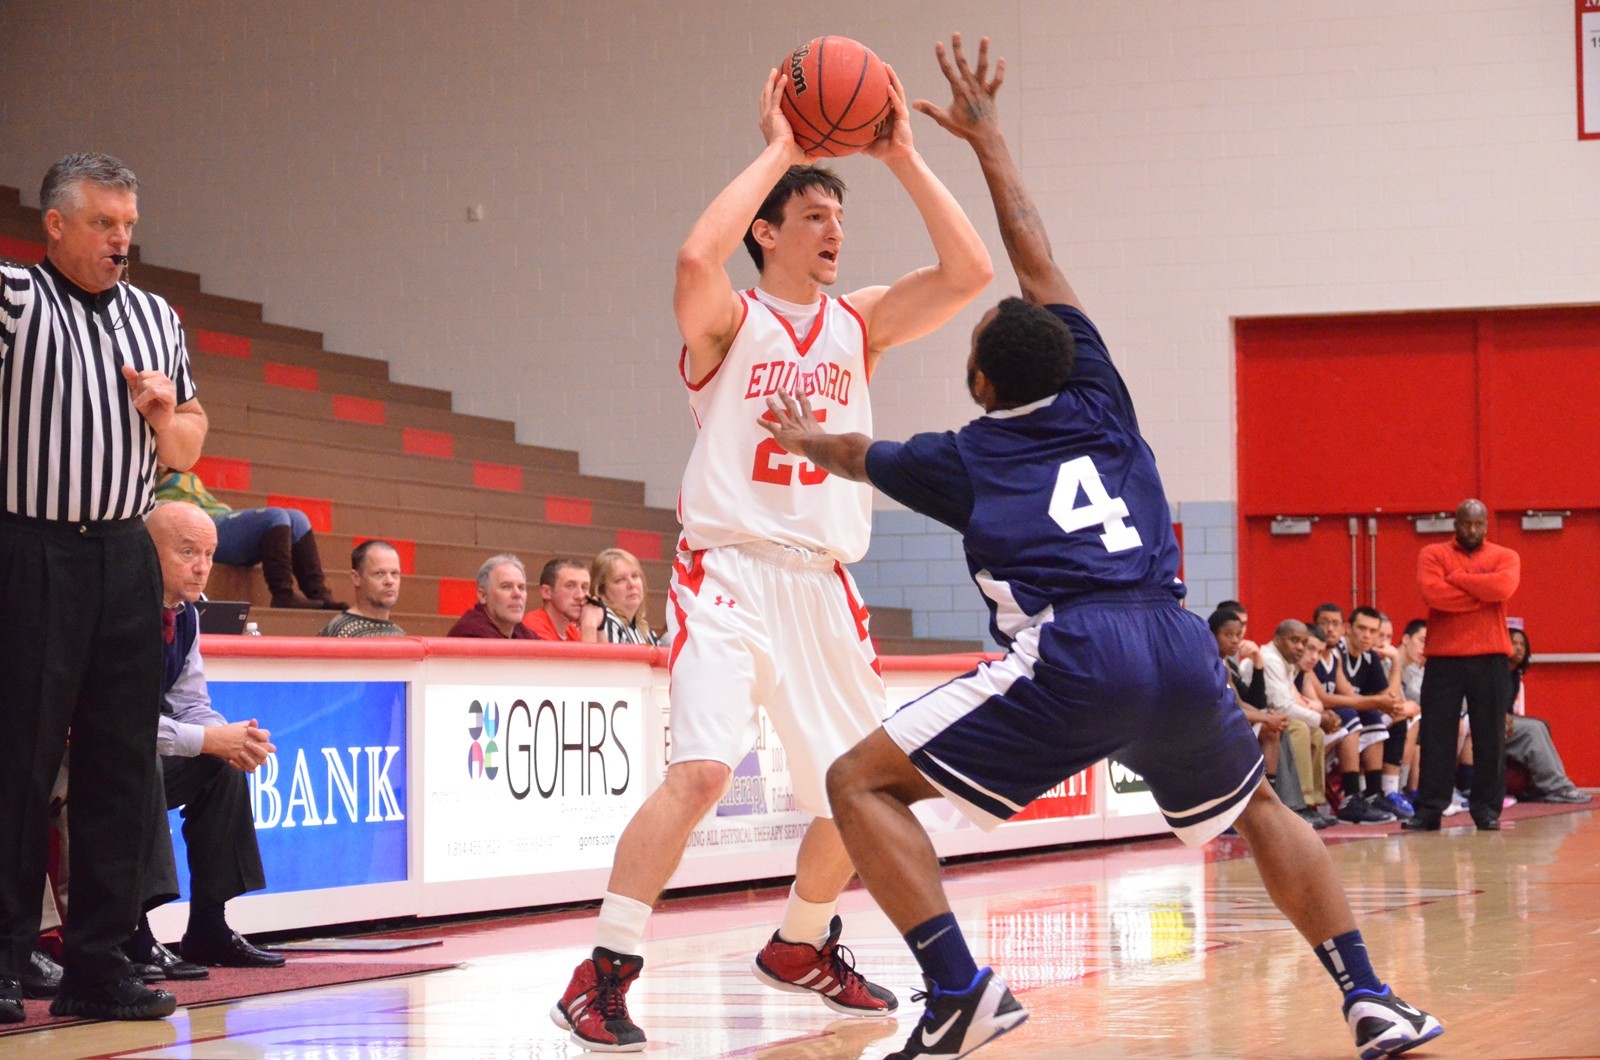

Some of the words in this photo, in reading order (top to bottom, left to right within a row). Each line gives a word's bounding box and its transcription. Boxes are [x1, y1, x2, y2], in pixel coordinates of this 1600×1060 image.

[1048, 455, 1143, 553] 4
[250, 746, 405, 829] BANK
[505, 699, 630, 800] GOHRS
[578, 833, 616, 850] gohrs.com
[706, 829, 719, 846] ALL
[720, 827, 753, 845] PHYSICAL
[754, 824, 784, 842] THERAPY
